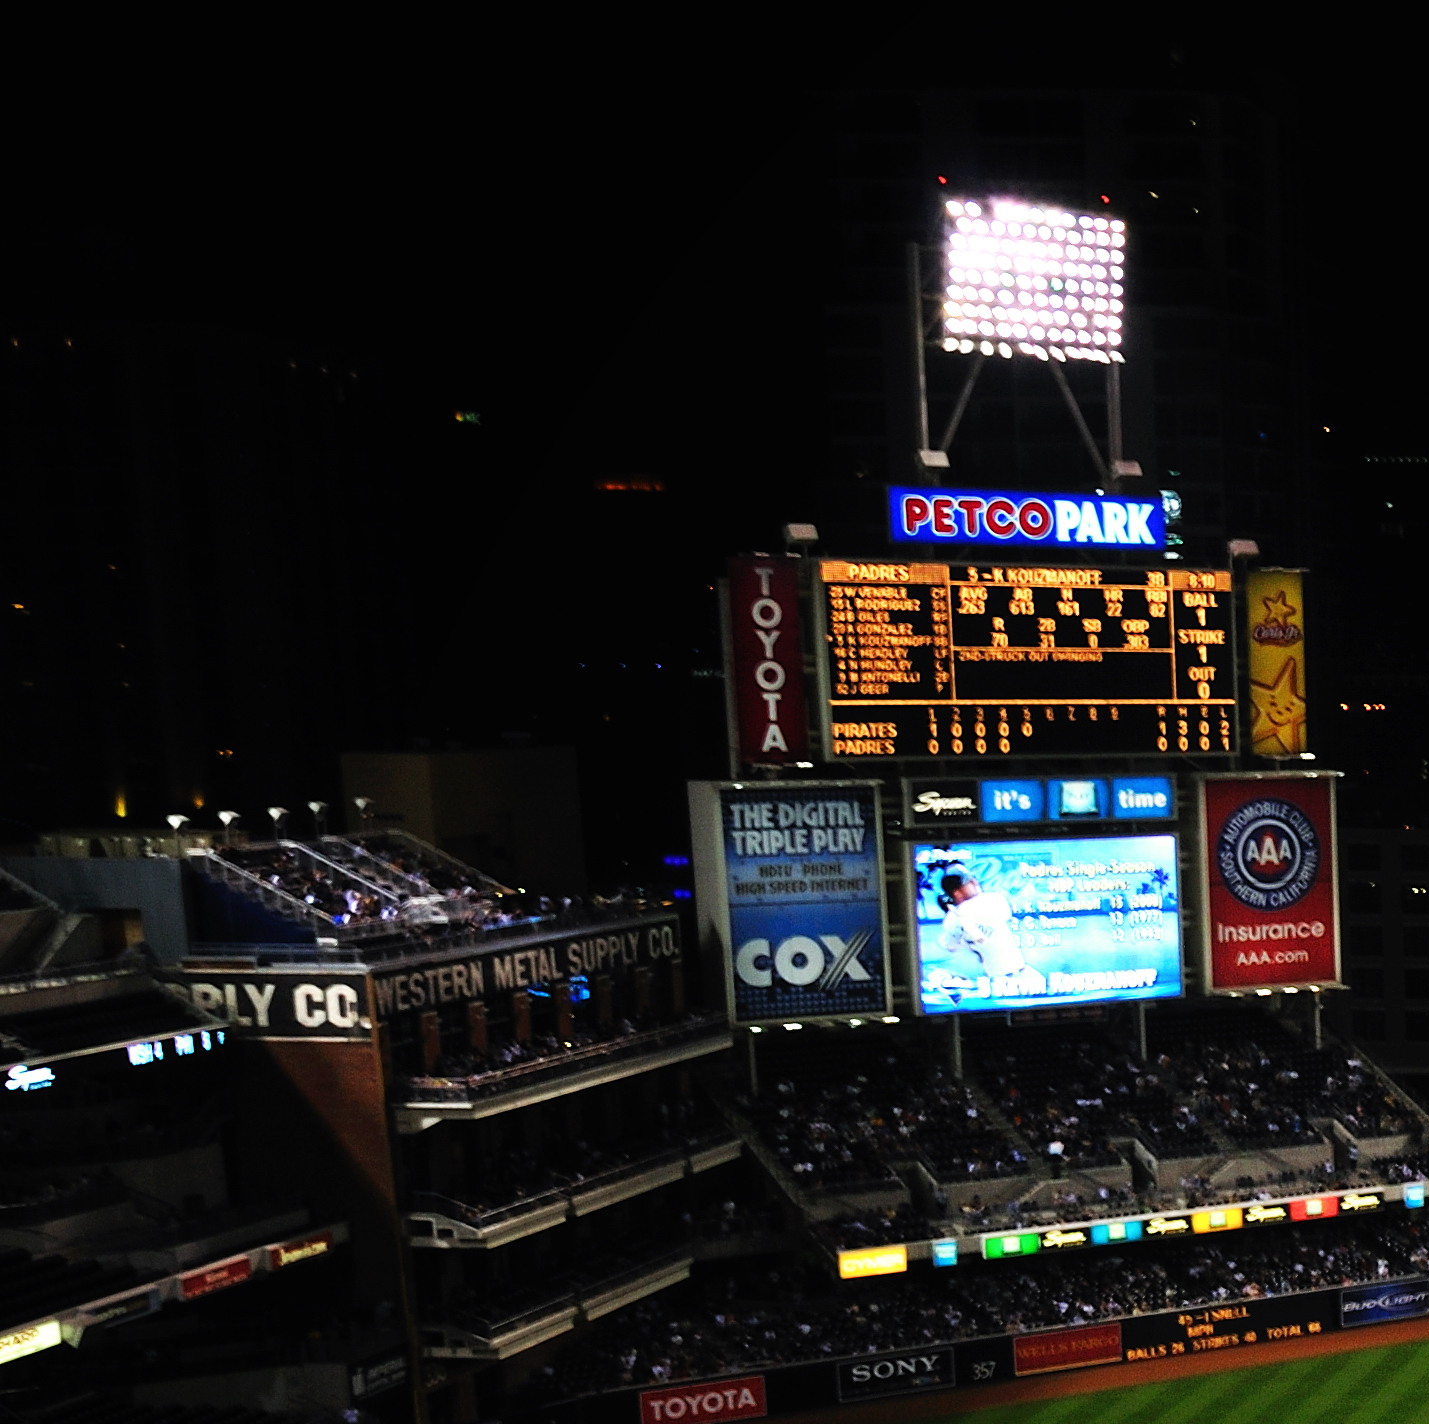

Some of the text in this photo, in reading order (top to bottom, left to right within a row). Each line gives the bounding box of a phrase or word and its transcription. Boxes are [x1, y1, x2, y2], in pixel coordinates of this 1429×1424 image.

[903, 495, 1156, 544] PETCO PARK
[849, 563, 910, 581] PADRES
[1007, 568, 1102, 585] KOUZMANOFF
[1189, 573, 1215, 588] 8:10
[959, 587, 987, 600] AVG
[1013, 588, 1033, 600] AB
[1061, 588, 1073, 600] H
[1104, 588, 1123, 601] HR
[1183, 593, 1218, 607] BALL
[992, 617, 1005, 631] R
[1121, 620, 1149, 633] OBP
[1195, 608, 1206, 626] 1
[991, 632, 1008, 648] 70
[1087, 633, 1098, 648] 0
[1178, 630, 1225, 645] STRIKE
[751, 567, 789, 752] TOYOTA
[1197, 646, 1207, 663] 1
[1187, 666, 1216, 682] OUT
[1197, 682, 1210, 699] 0
[832, 722, 898, 738] PIRATES
[929, 722, 938, 737] 1
[951, 722, 963, 737] 0
[974, 722, 986, 737] 0
[998, 722, 1010, 737] 0
[1021, 722, 1033, 737] 0
[1199, 721, 1210, 735] 0
[834, 739, 895, 754] PADRES
[927, 739, 940, 754] 0
[951, 739, 964, 754] 0
[975, 739, 987, 754] 0
[998, 739, 1011, 754] 0
[1157, 737, 1168, 752] 0
[1178, 737, 1189, 752] 0
[1199, 737, 1211, 752] 0
[994, 790, 1031, 810] it's
[1118, 789, 1167, 809] time
[730, 801, 864, 829] THE DIGITAL
[1223, 801, 1314, 844] AUTOMOBILE CLUB
[732, 828, 864, 856] TRIPLE PLAY
[1247, 835, 1293, 866] AAA
[803, 863, 843, 876] PHONE
[1220, 849, 1318, 907] SOUTHERN CALIFORNIA
[735, 878, 868, 896] HIGH SPEED INTERNET
[1217, 921, 1325, 943] Insurance
[736, 930, 875, 991] COX
[1236, 950, 1310, 967] AAA.com
[374, 925, 679, 1015] WESTERN METAL SUPPLY CO.
[292, 983, 373, 1030] CO.
[843, 1253, 904, 1272] CYMER
[1018, 1334, 1119, 1359] WELLS FARGO
[1127, 1344, 1167, 1361] BALLS
[1267, 1323, 1304, 1341] TOTAL
[852, 1355, 940, 1382] SONY
[972, 1360, 996, 1381] 357
[651, 1388, 757, 1421] TOYOTA
